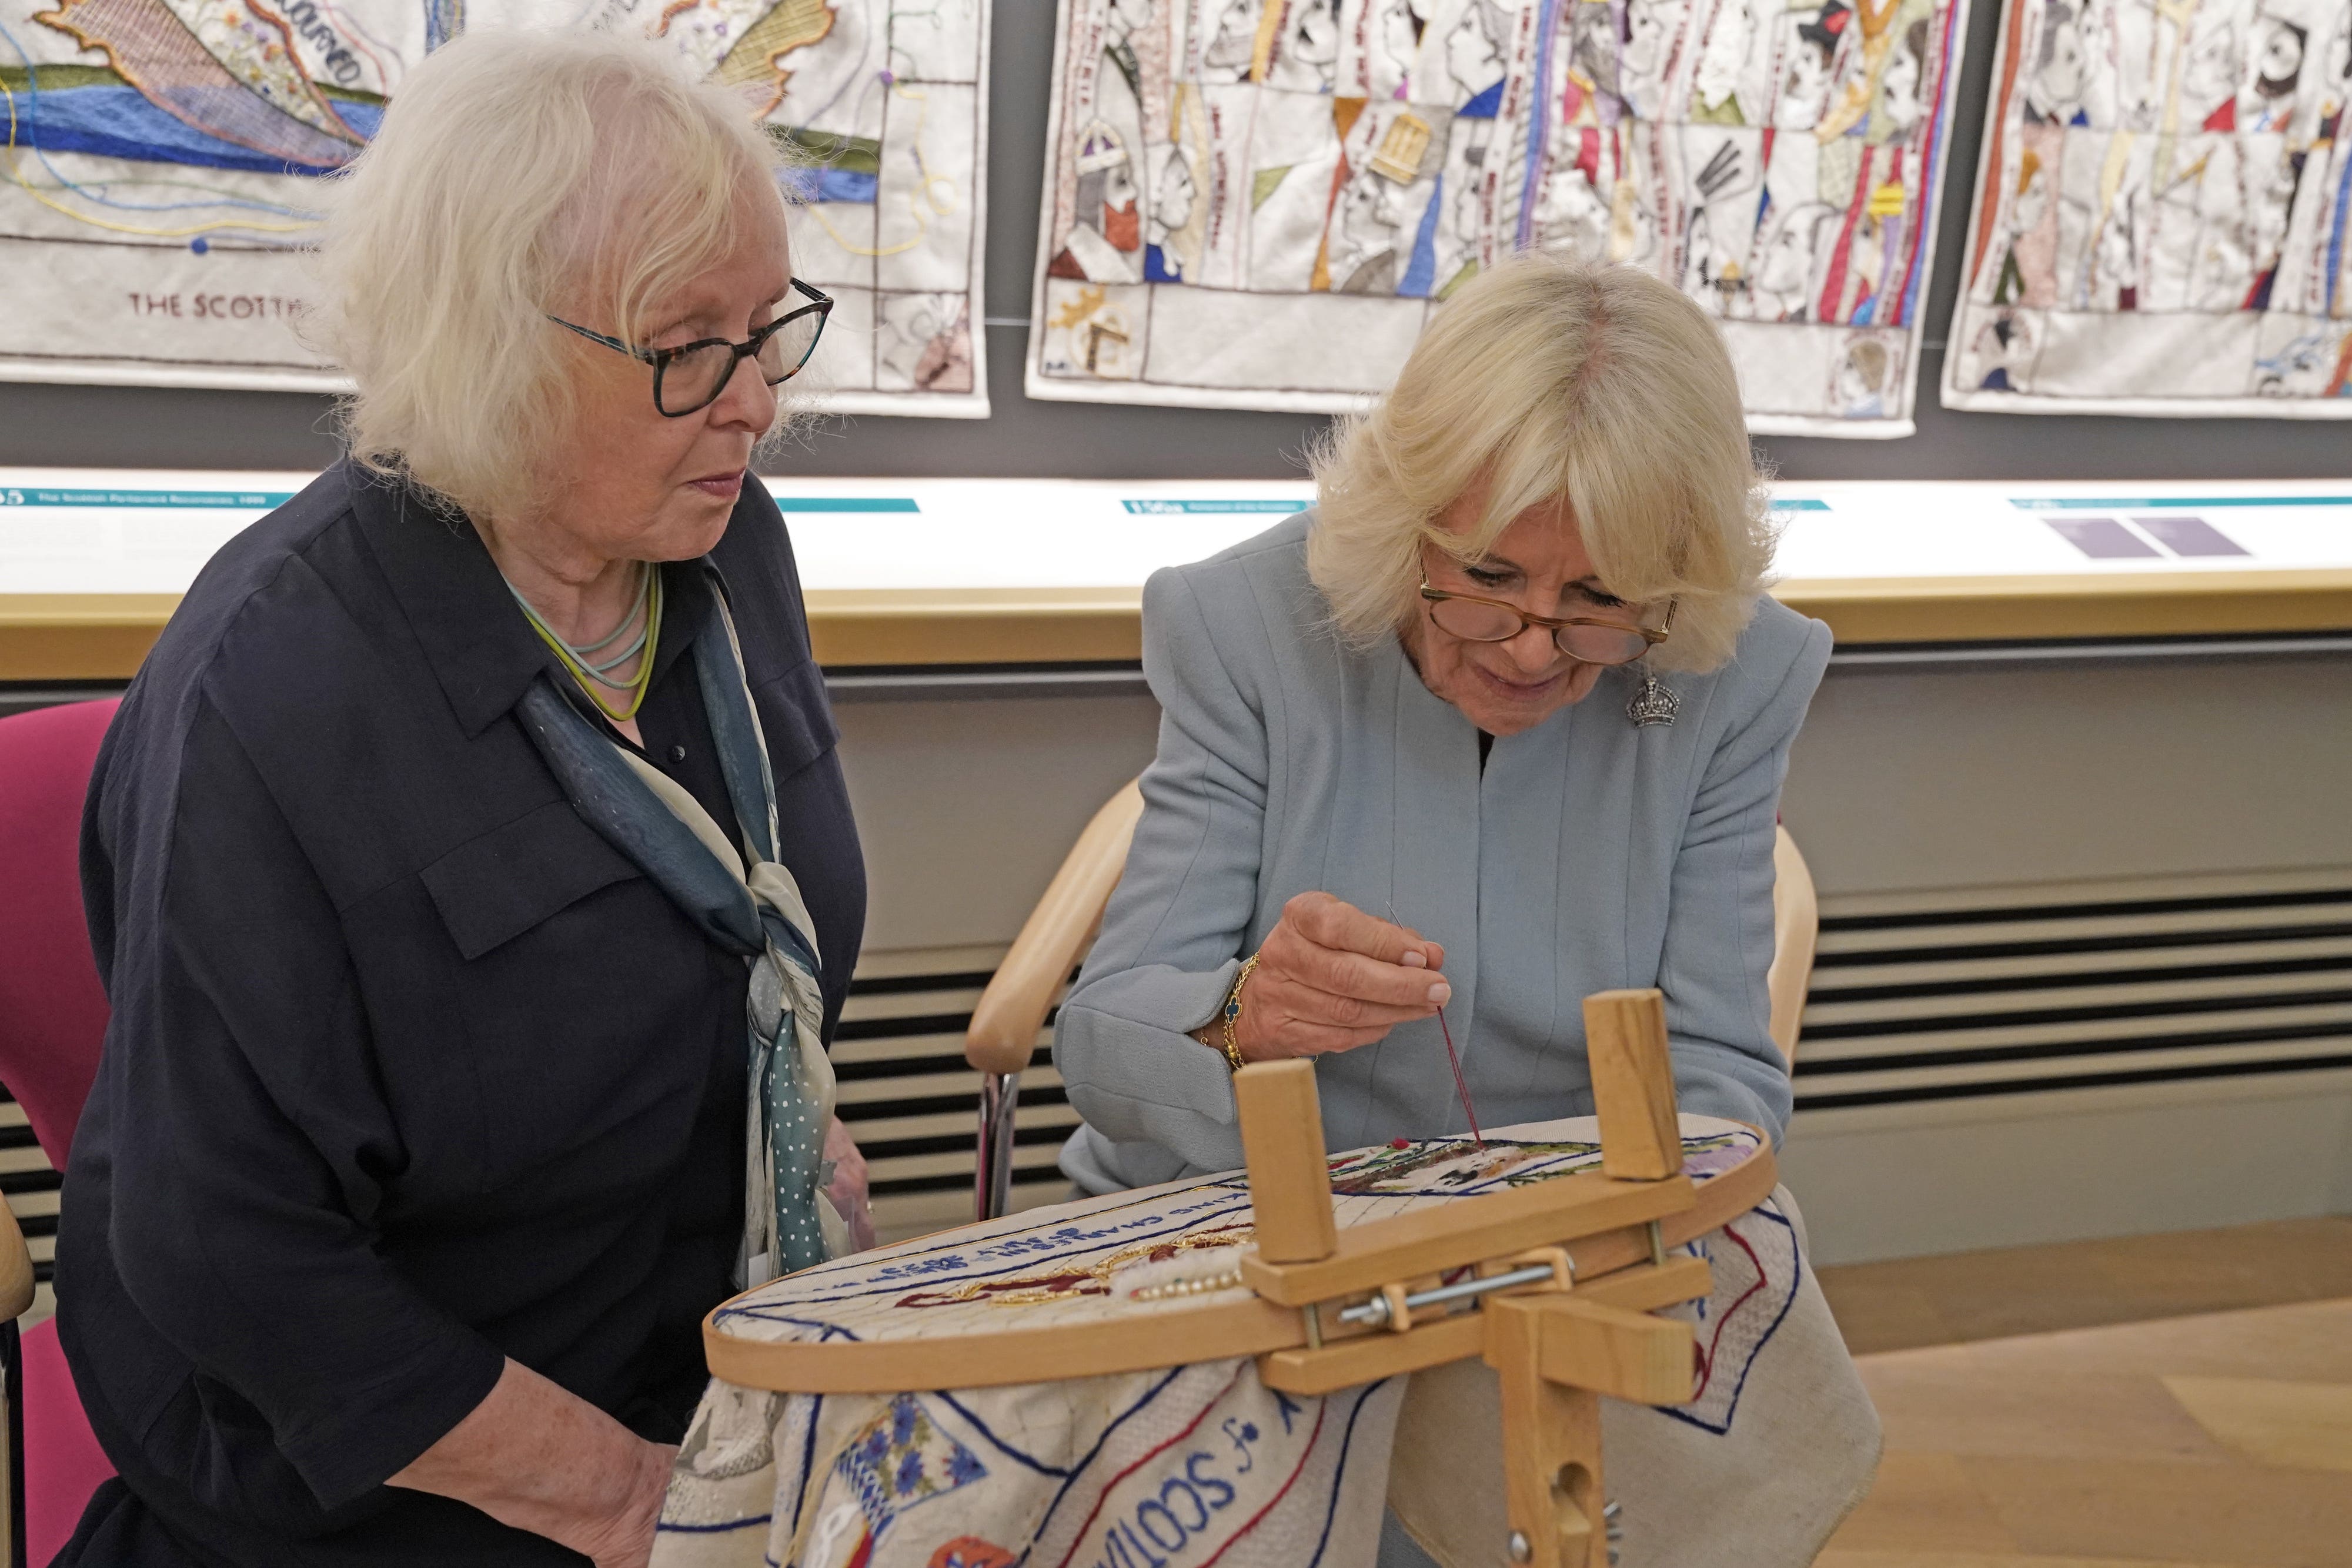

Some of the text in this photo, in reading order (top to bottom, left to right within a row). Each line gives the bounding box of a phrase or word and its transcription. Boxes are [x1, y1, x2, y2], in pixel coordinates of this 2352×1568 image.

[128, 293, 182, 317] THE
[1168, 1192, 1248, 1215] KING
[1031, 1216, 1164, 1251] CHARLES
[977, 1236, 1043, 1256] JULY
